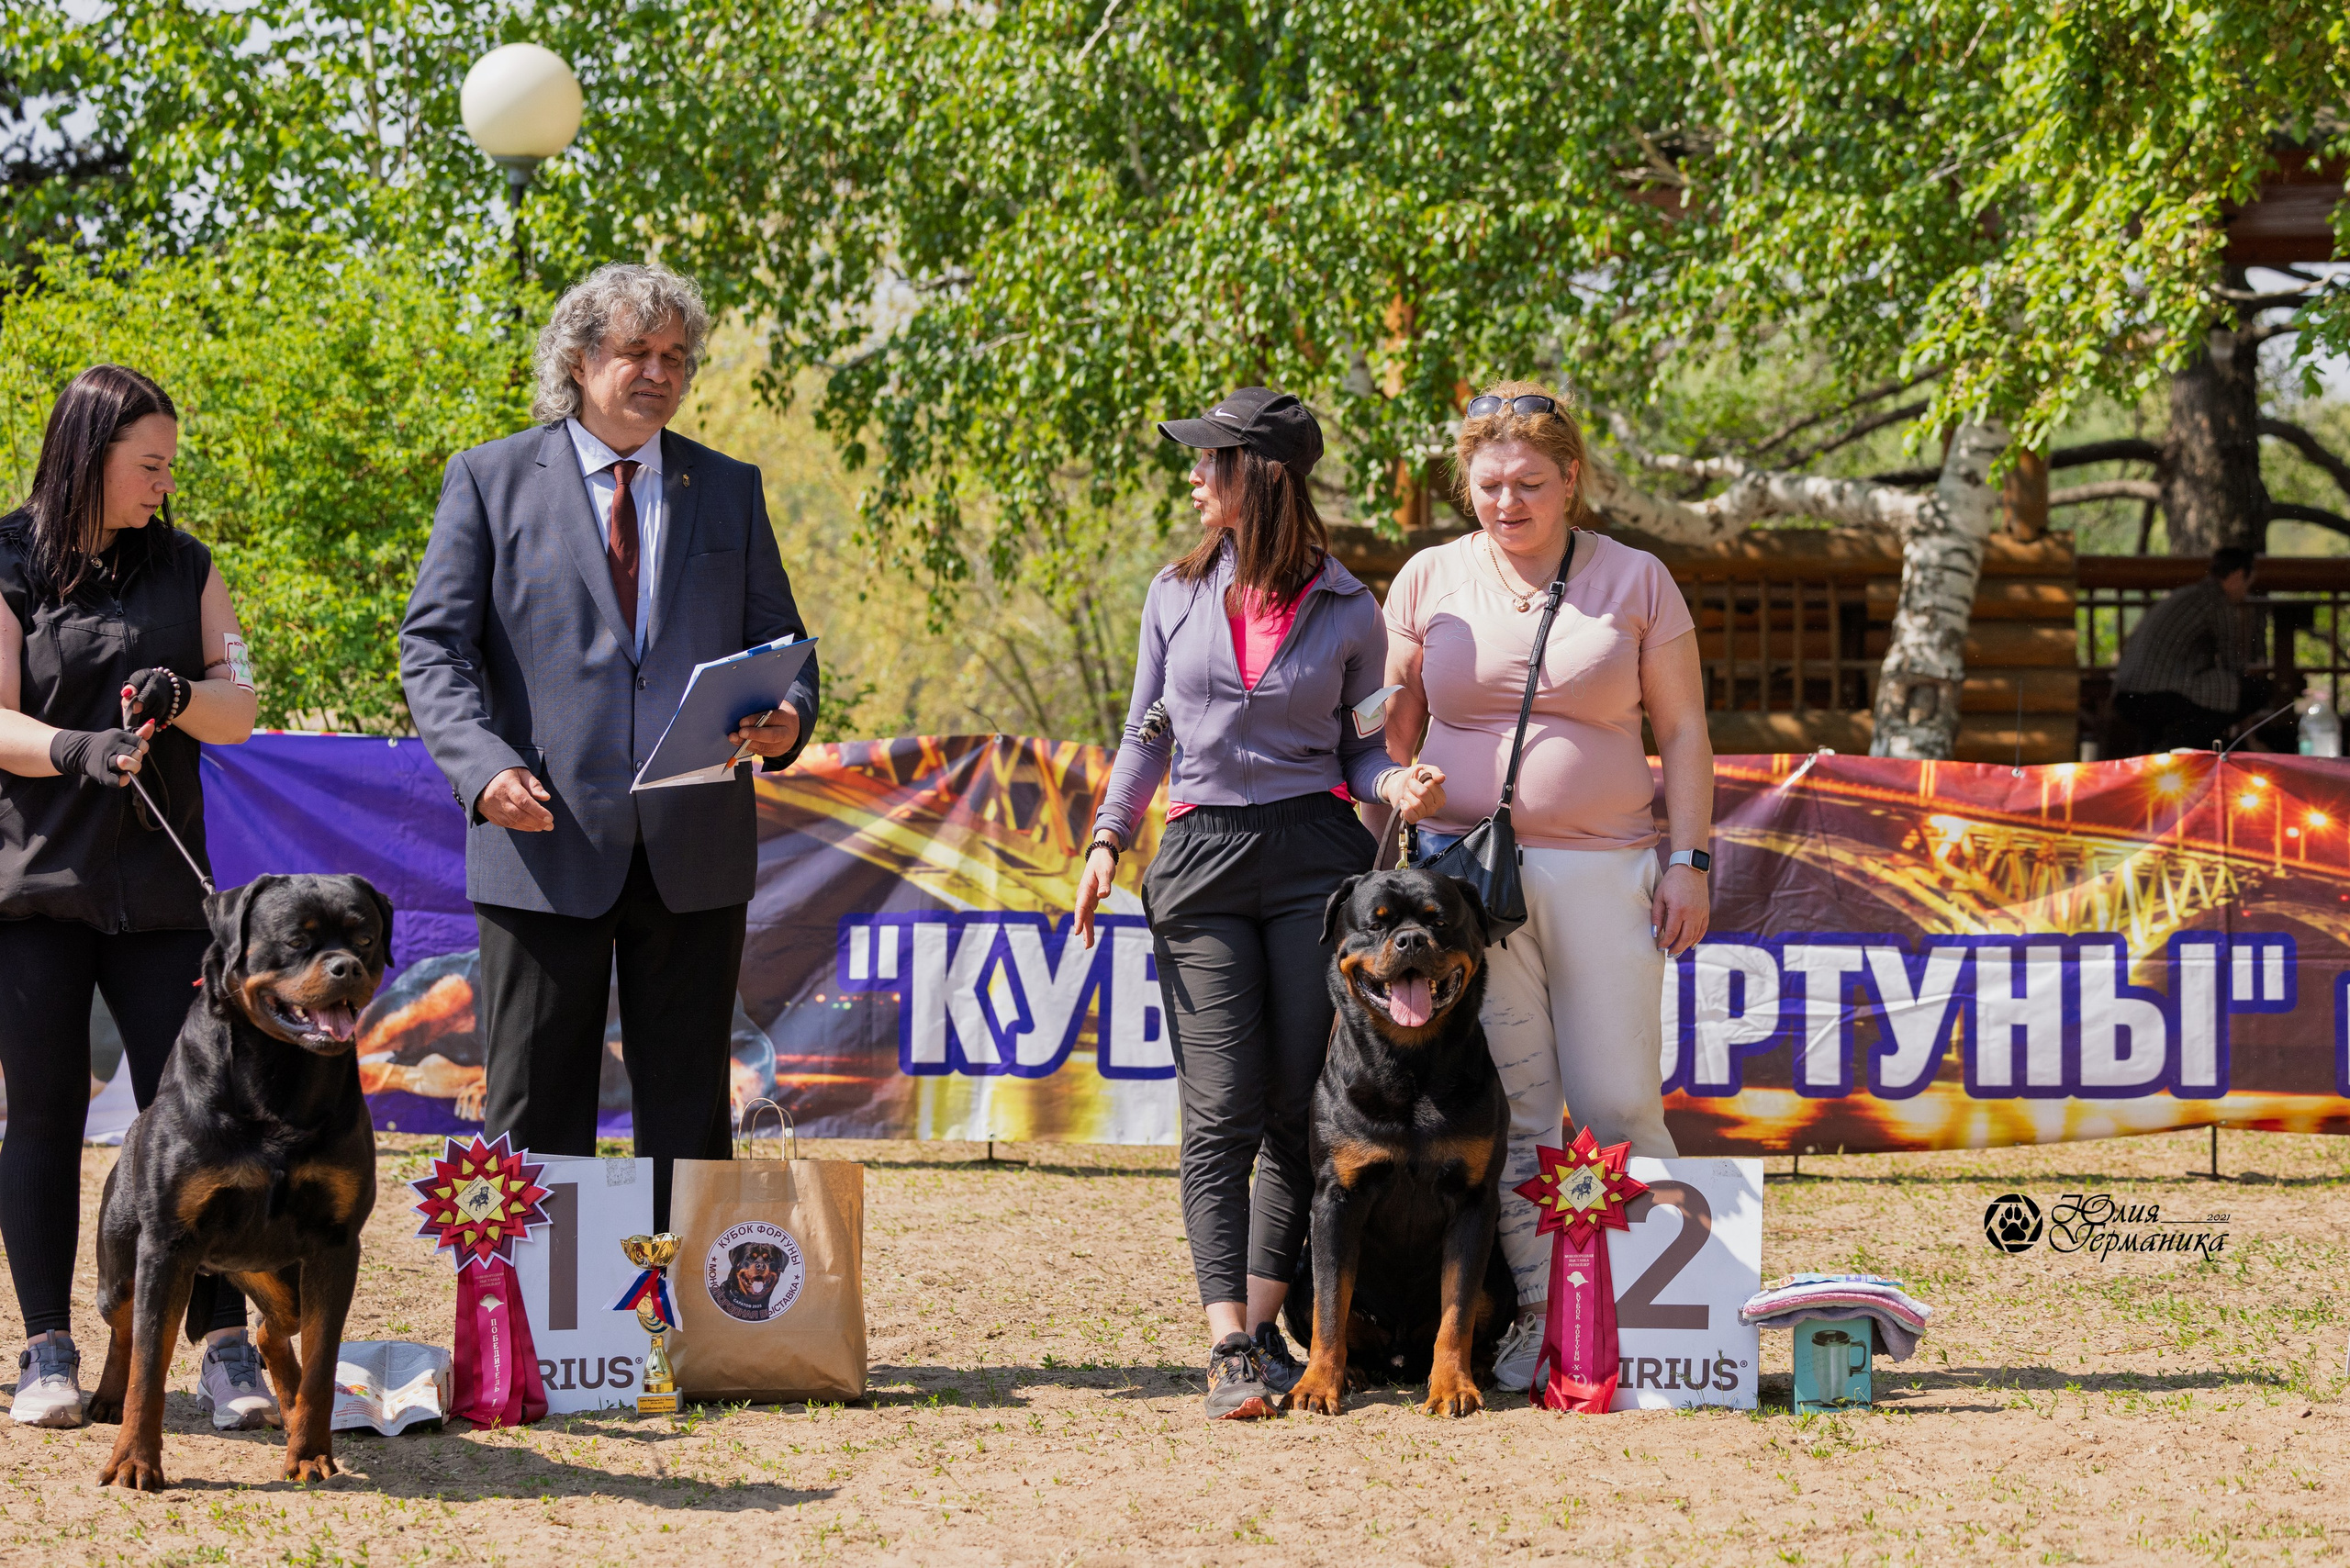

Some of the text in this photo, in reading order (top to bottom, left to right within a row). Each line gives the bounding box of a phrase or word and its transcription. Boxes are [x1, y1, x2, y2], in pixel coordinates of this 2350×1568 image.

[849, 922, 1175, 1068] "КУБ
[1660, 942, 2284, 1087] РТУНЫ"
[537, 1182, 578, 1330] 1
[718, 1225, 801, 1266] КУБОК ФОРТУНЫ
[1616, 1180, 1712, 1329] 2
[733, 1298, 752, 1308] САРАТОВ
[759, 1282, 800, 1319] ВЫСТАВКА
[490, 1318, 501, 1393] ПОБЕДИТЕЛЬ
